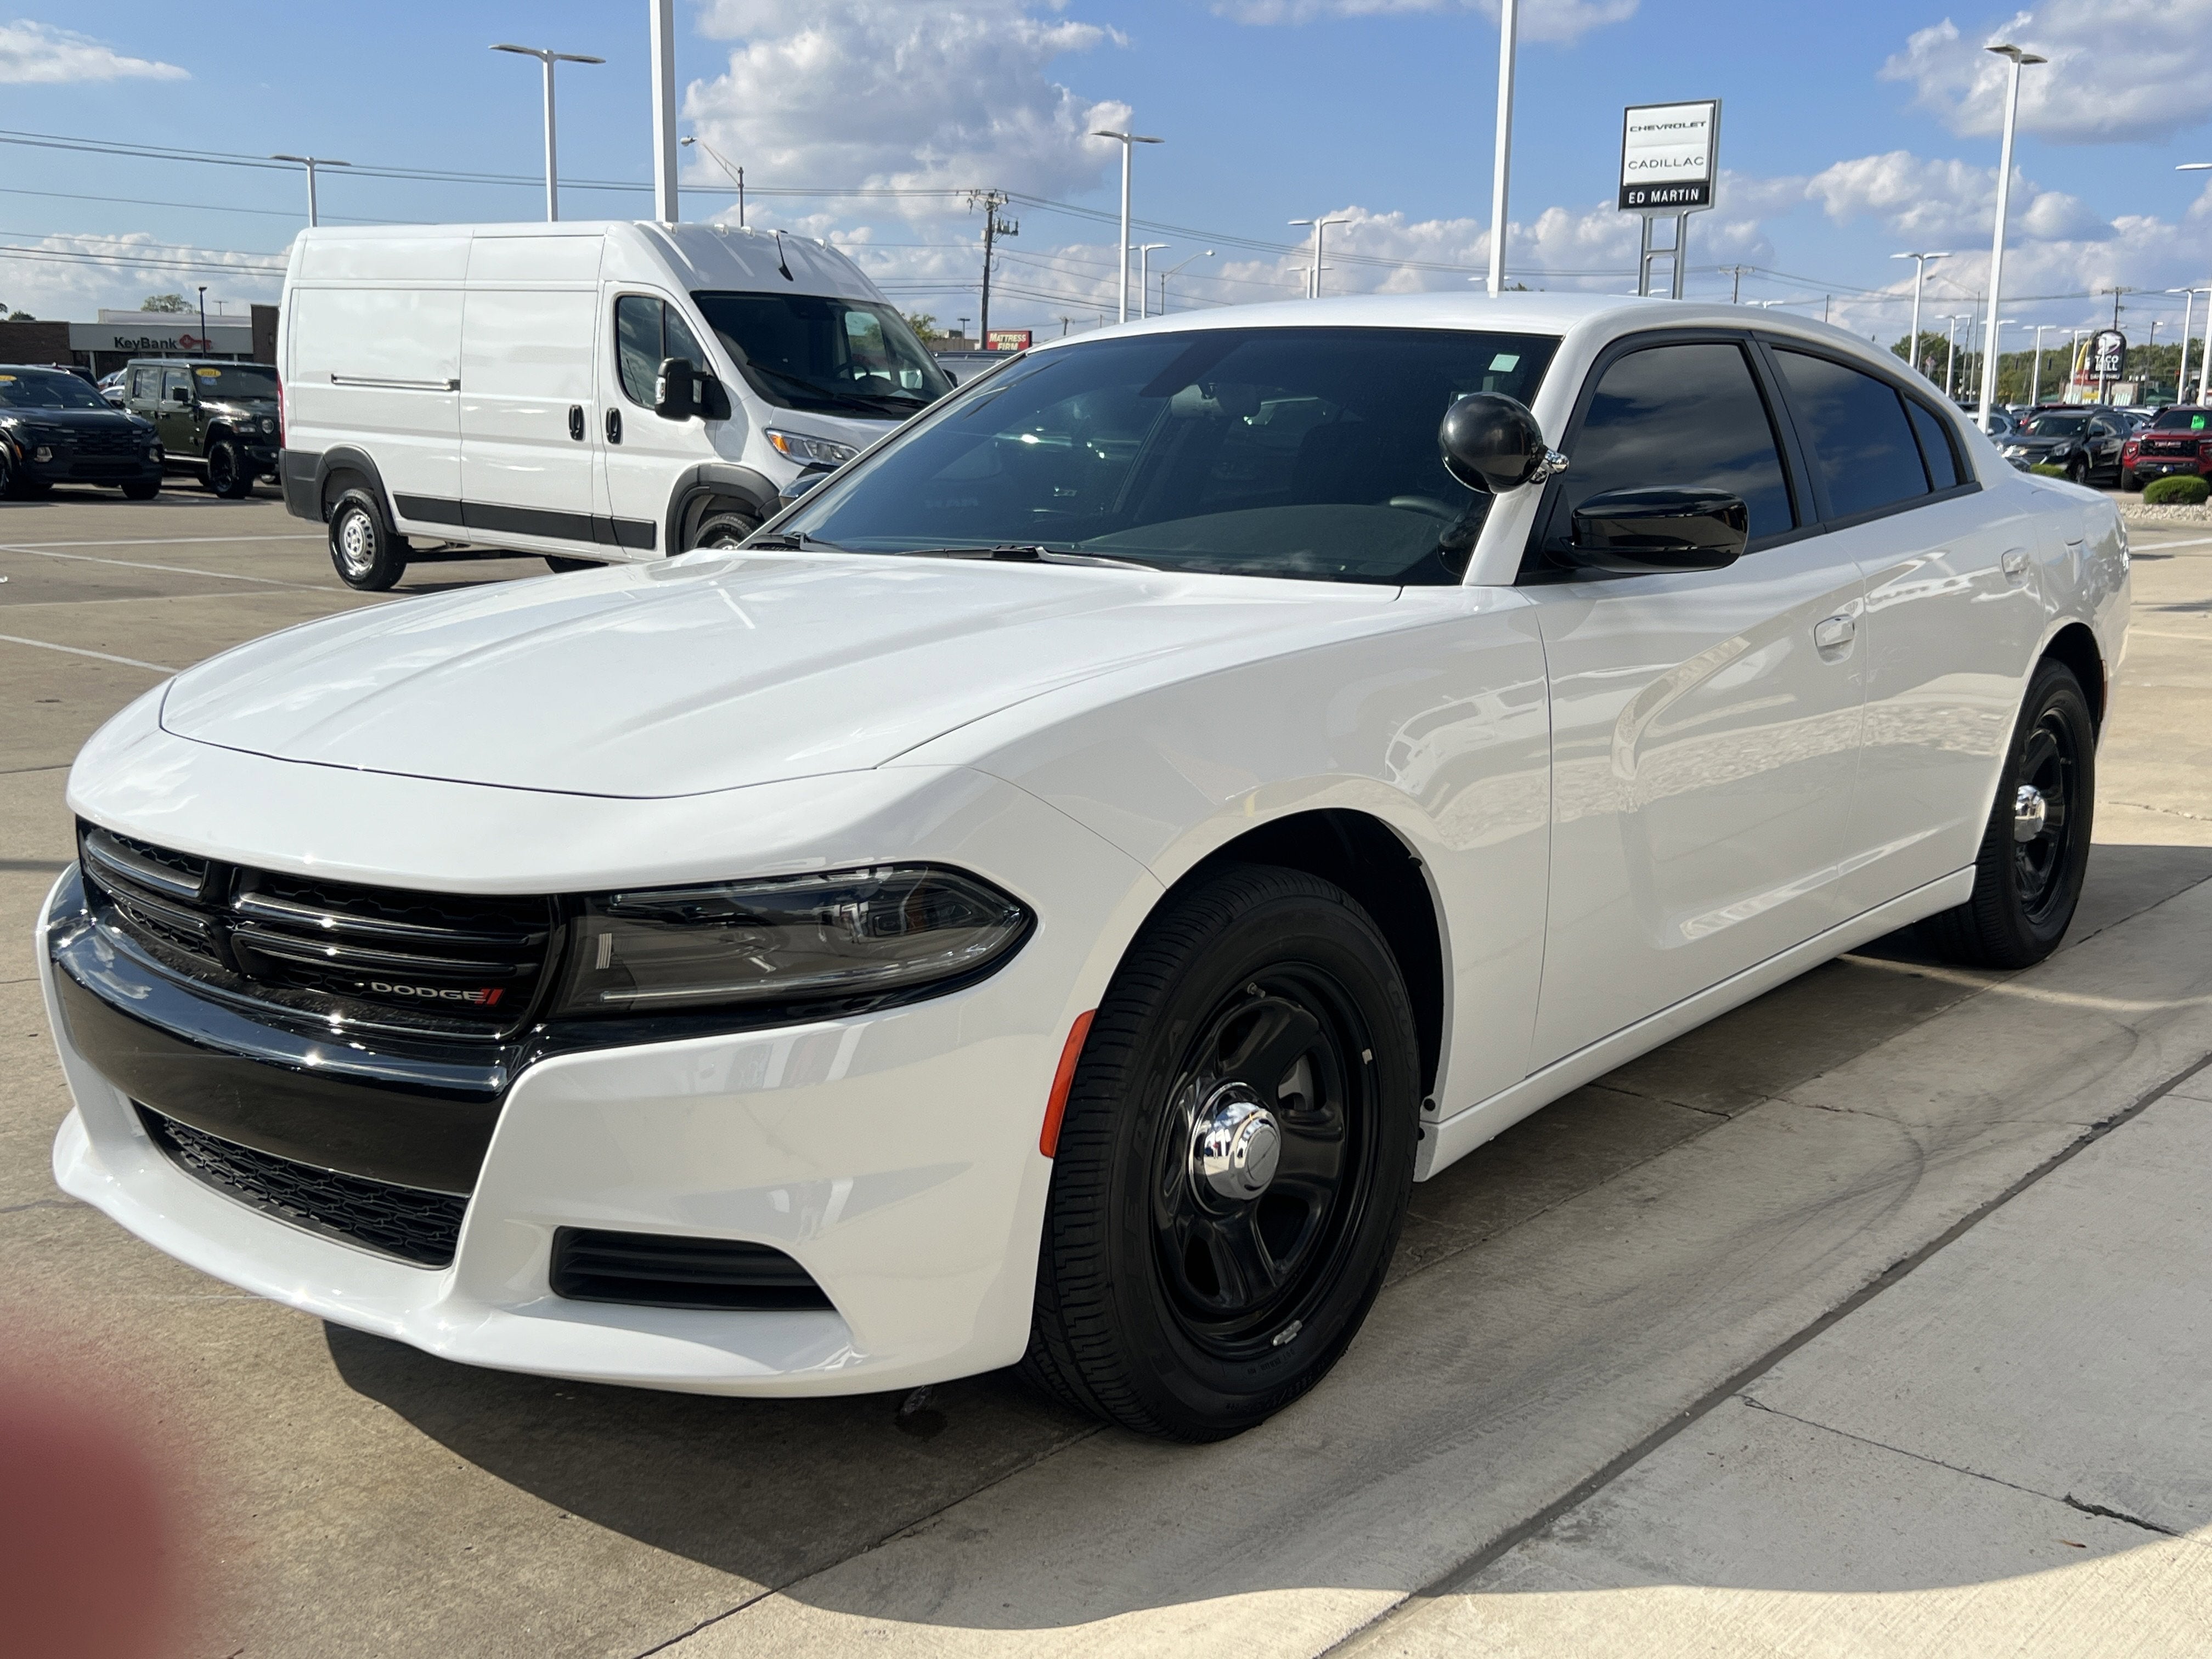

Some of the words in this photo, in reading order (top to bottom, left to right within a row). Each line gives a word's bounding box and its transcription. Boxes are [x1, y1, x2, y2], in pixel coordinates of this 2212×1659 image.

[1629, 121, 1707, 133] CHEVROLET
[1628, 156, 1705, 170] CADILLAC
[1628, 191, 1645, 204] ED
[1651, 188, 1700, 202] MARTIN
[114, 337, 178, 351] KeyBank
[989, 333, 1026, 342] MATTRESS
[997, 342, 1019, 351] FIRM
[2095, 355, 2119, 363] TACO
[371, 981, 487, 1002] DODGE
